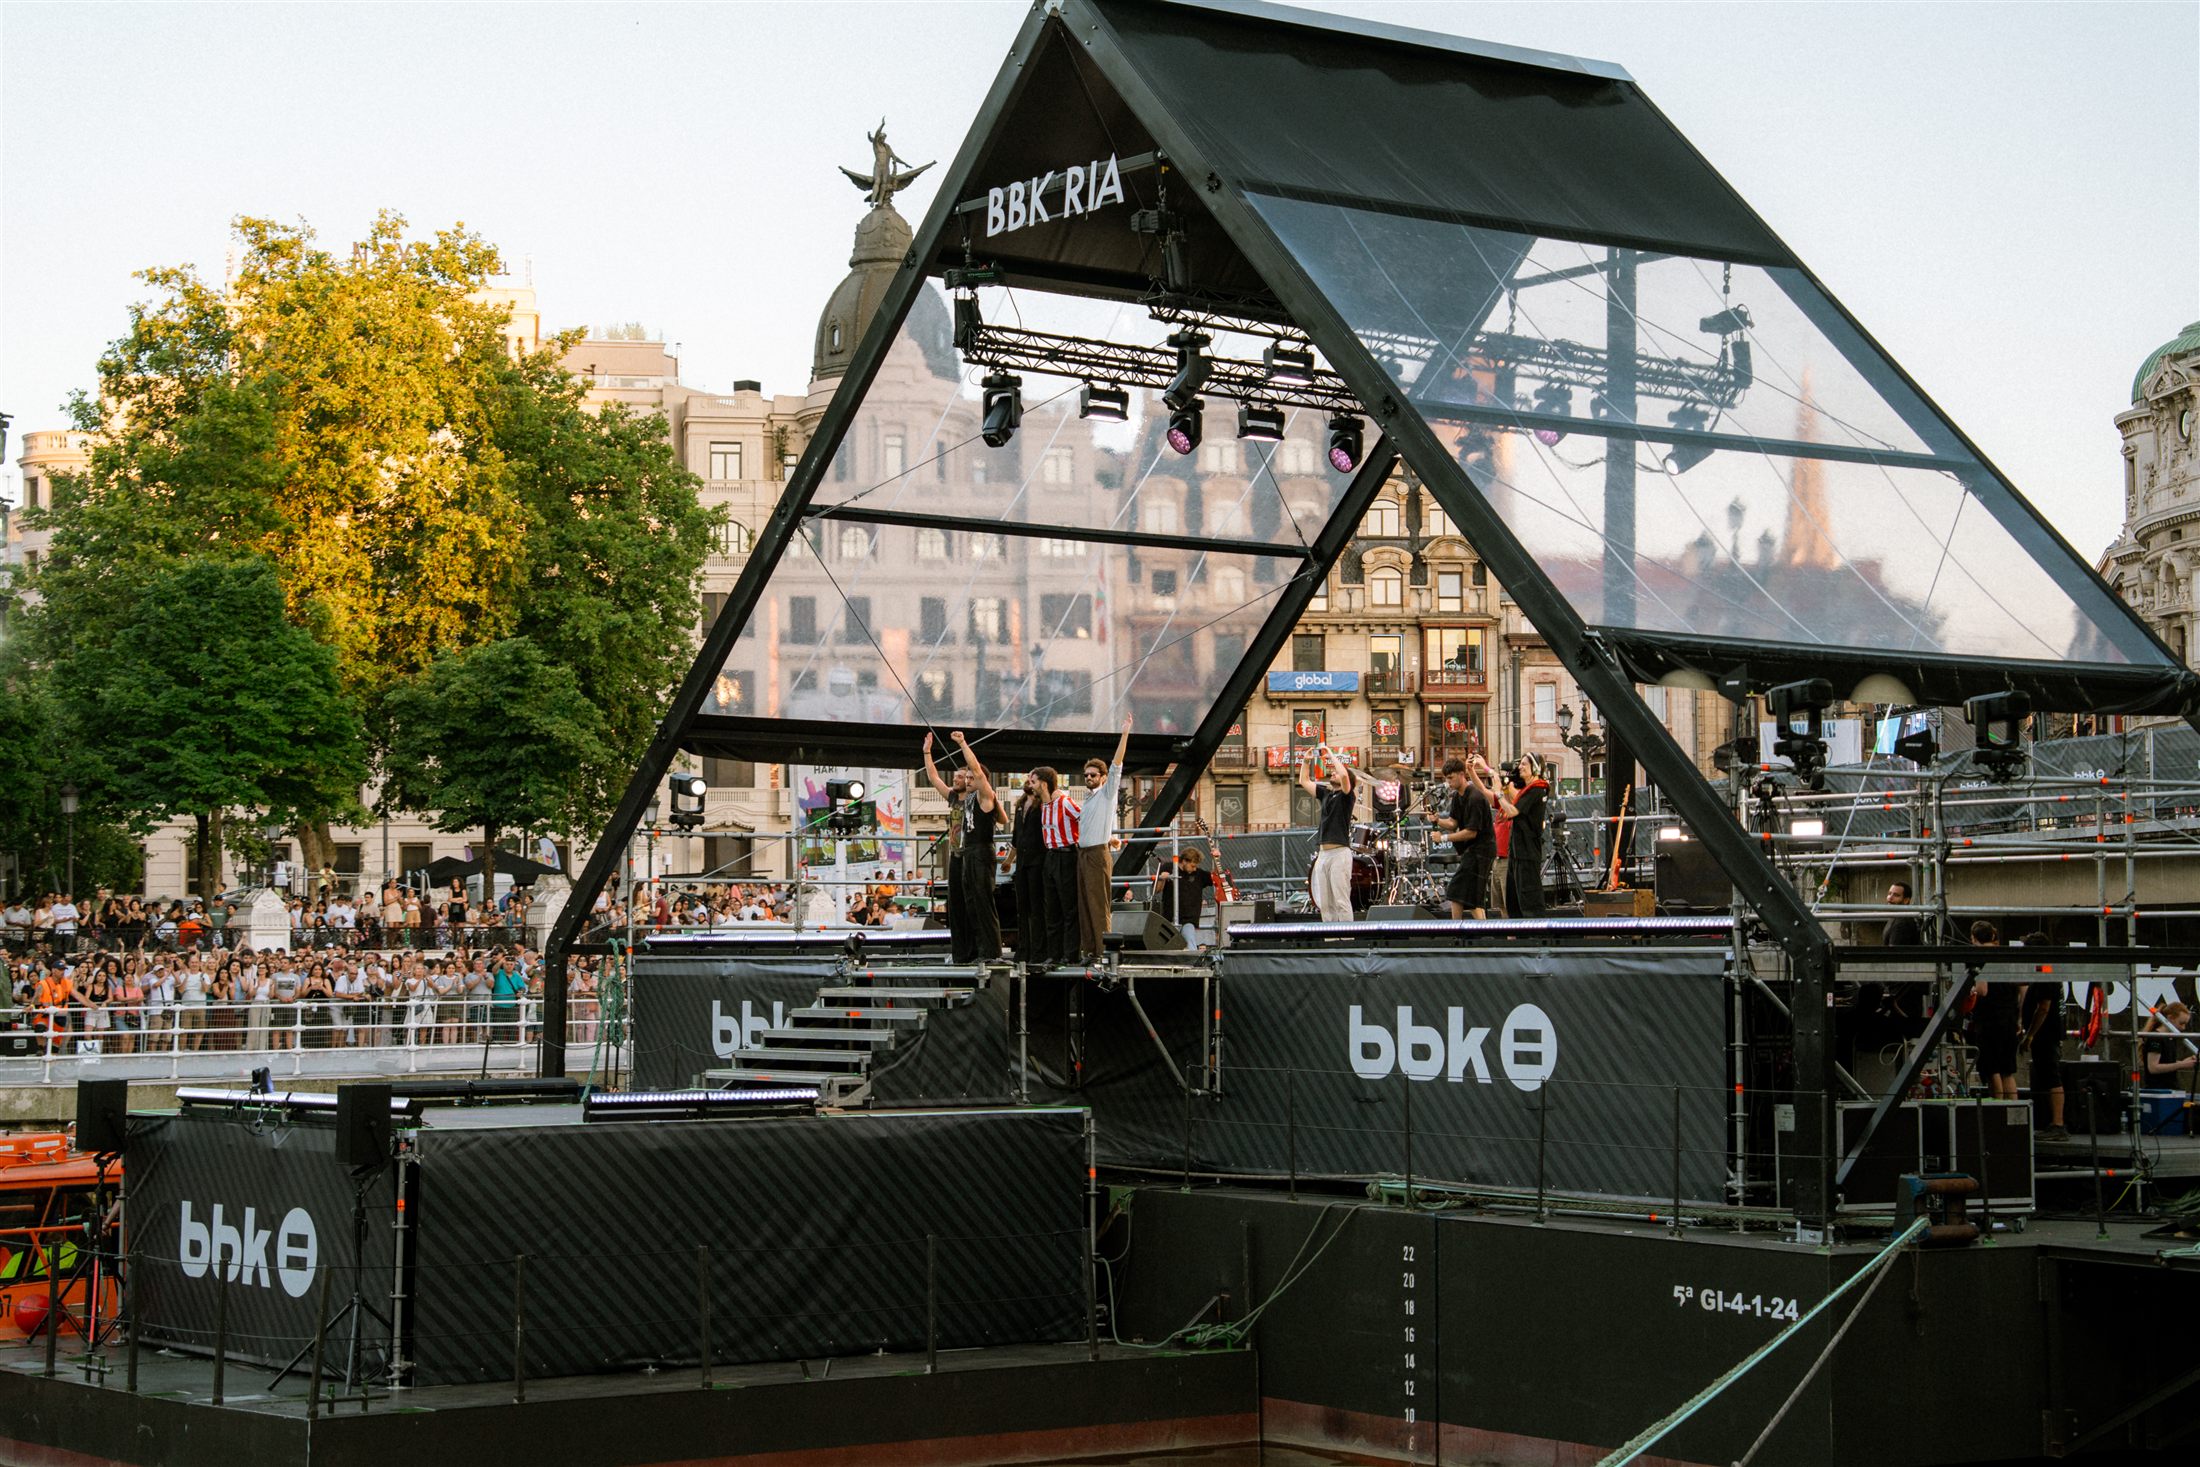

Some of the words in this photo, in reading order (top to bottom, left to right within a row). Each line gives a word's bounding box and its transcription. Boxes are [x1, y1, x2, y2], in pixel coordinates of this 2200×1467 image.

[987, 170, 1055, 238] BBK
[1064, 151, 1124, 218] RIA
[1295, 673, 1333, 690] global
[1239, 860, 1253, 869] bbk
[1349, 1005, 1492, 1083] bbk
[180, 1200, 272, 1288] bbk
[1403, 1245, 1415, 1262] 22
[1403, 1272, 1415, 1289] 20
[1404, 1299, 1415, 1315] 18
[1700, 1288, 1799, 1321] GI-4-1-24
[1404, 1326, 1415, 1342] 16
[1404, 1352, 1416, 1369] 14
[1404, 1380, 1415, 1396] 12
[1404, 1407, 1415, 1423] 10
